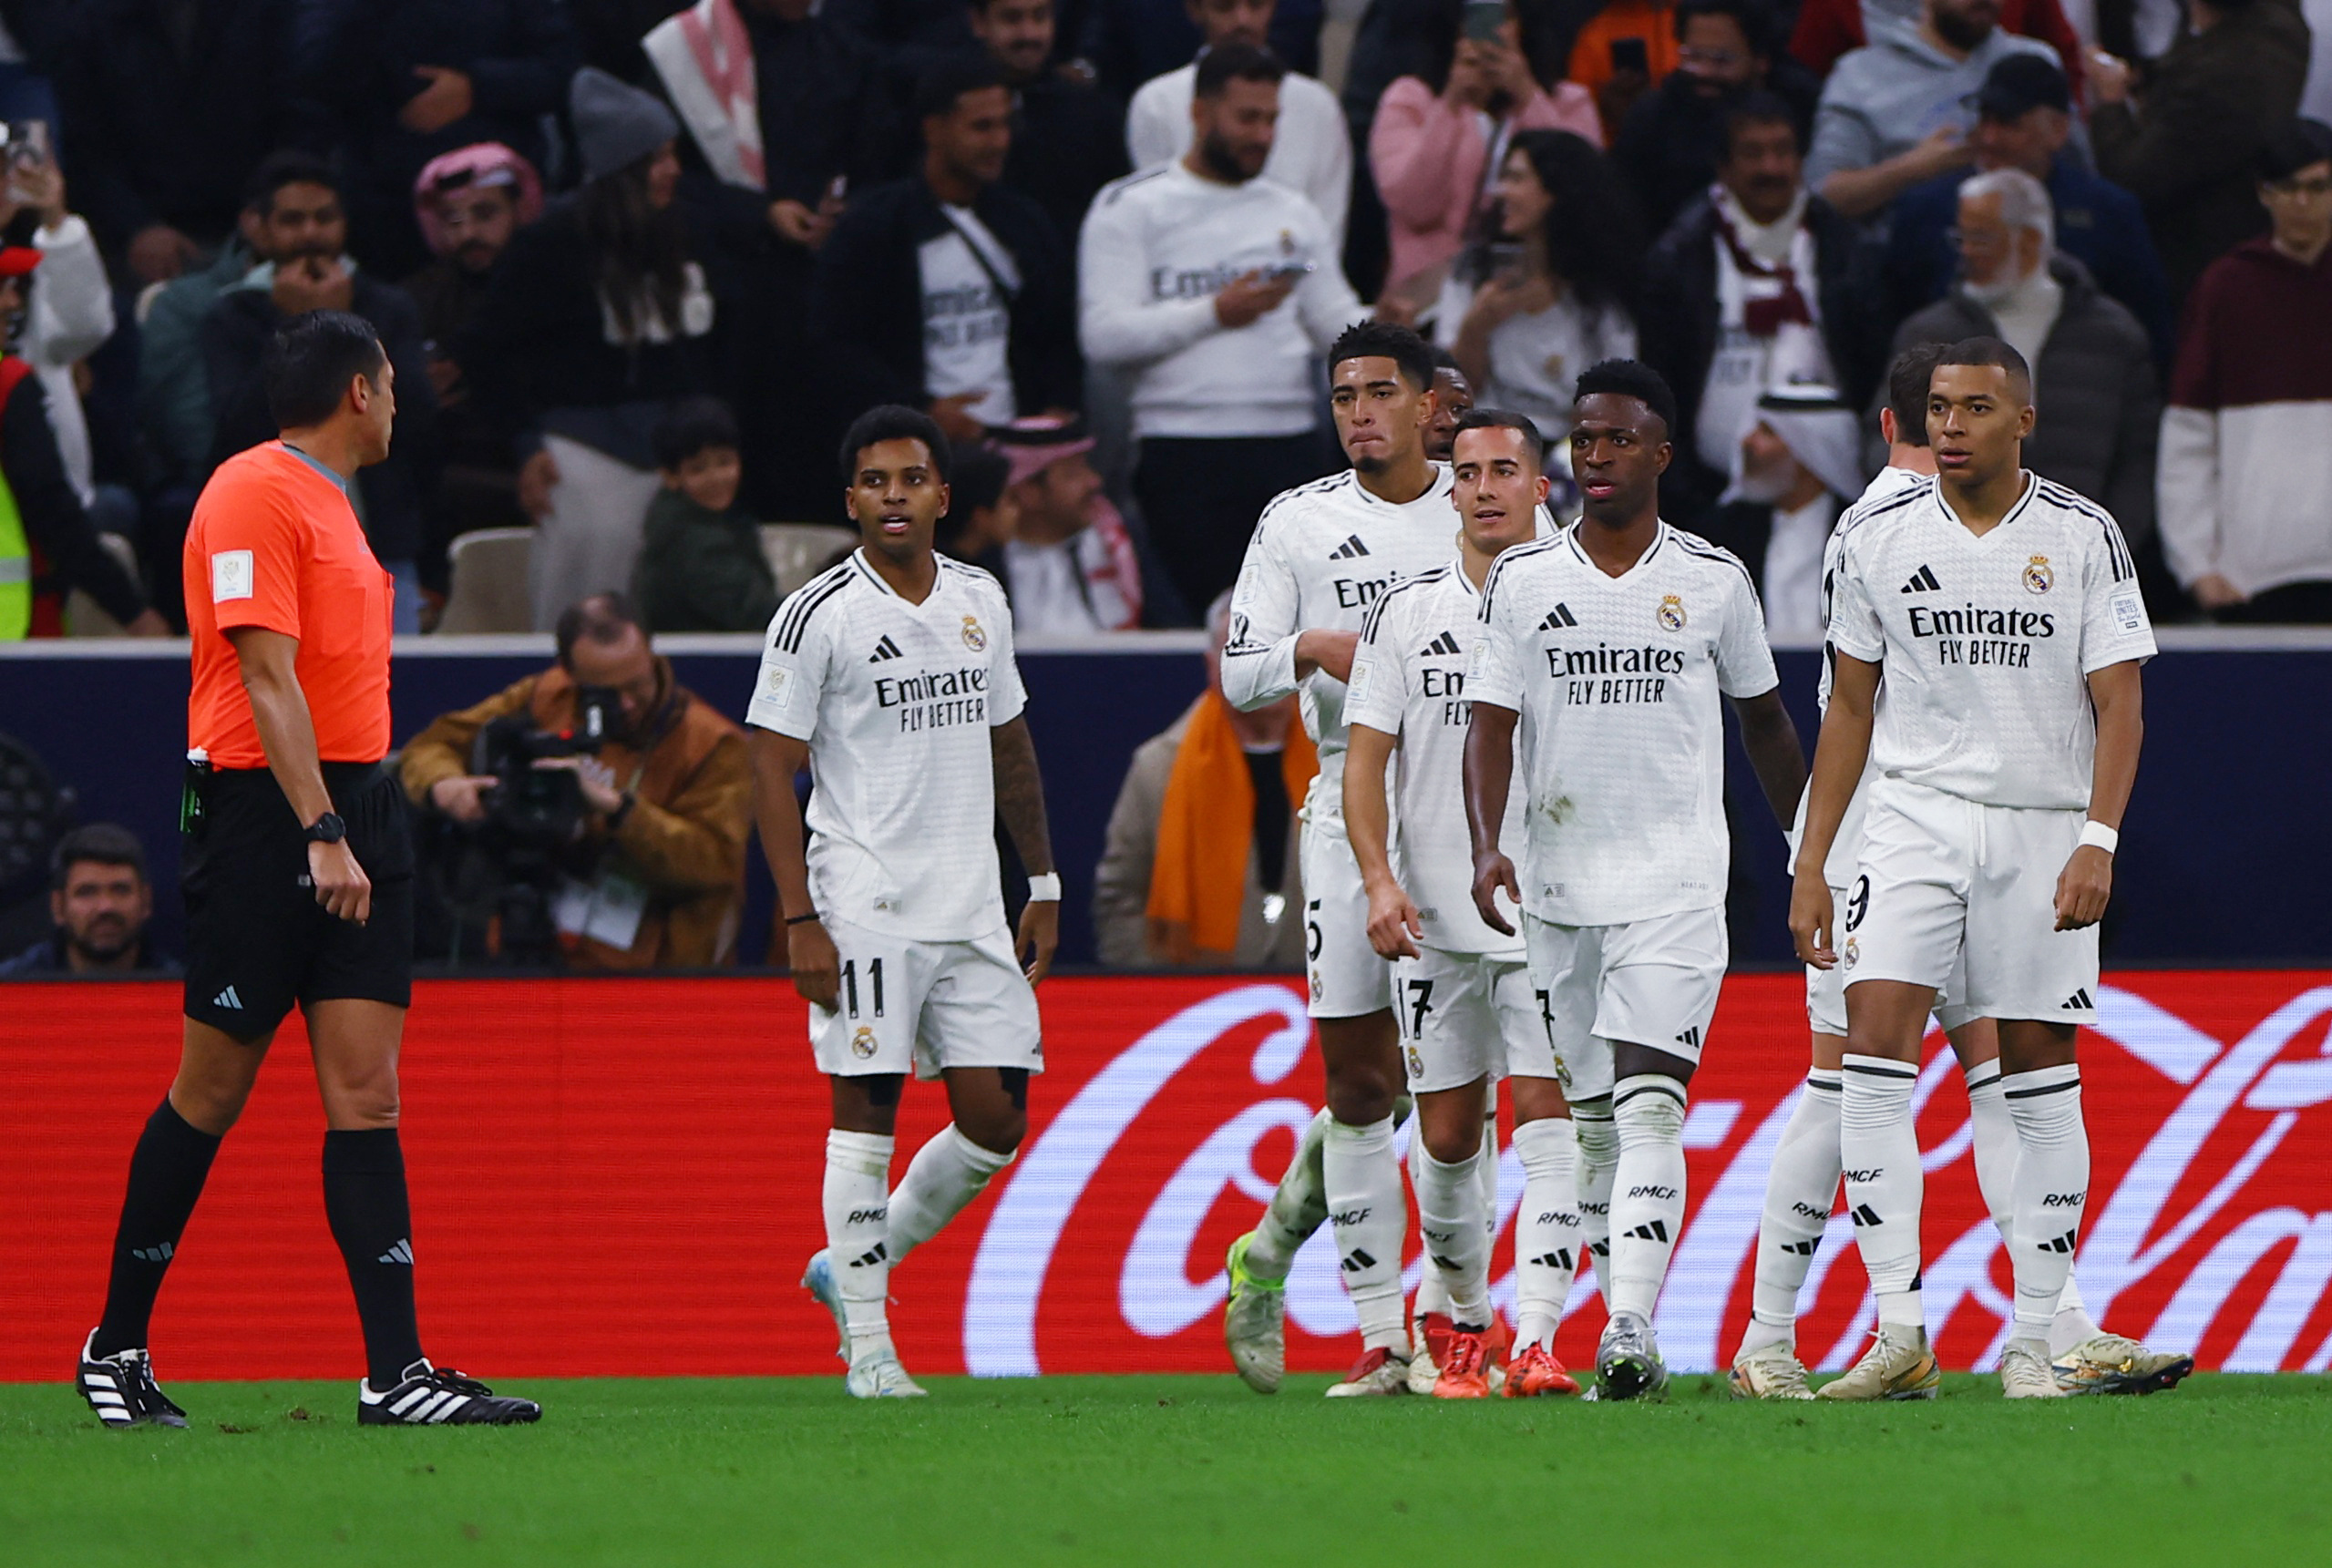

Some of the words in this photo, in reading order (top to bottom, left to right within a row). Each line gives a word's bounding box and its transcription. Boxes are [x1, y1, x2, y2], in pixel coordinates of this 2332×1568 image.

[1907, 602, 2054, 638] Emirates
[1546, 642, 1686, 679] Emirates
[1939, 641, 1962, 666] FLY
[1969, 640, 2030, 668] BETTER
[1568, 681, 1595, 705] FLY
[1600, 679, 1665, 703] BETTER
[901, 705, 923, 733] FLY
[929, 698, 985, 729] BETTER
[1845, 874, 1870, 932] 9
[840, 958, 884, 1020] 11
[1398, 977, 1433, 1040] 17
[1536, 989, 1555, 1050] 7
[1843, 1168, 1884, 1183] MCF
[1628, 1185, 1679, 1200] RMCF
[848, 1207, 888, 1224] RMC
[1577, 1200, 1608, 1216] RMC
[1792, 1202, 1833, 1221] RMC
[1423, 1226, 1455, 1243] MCF
